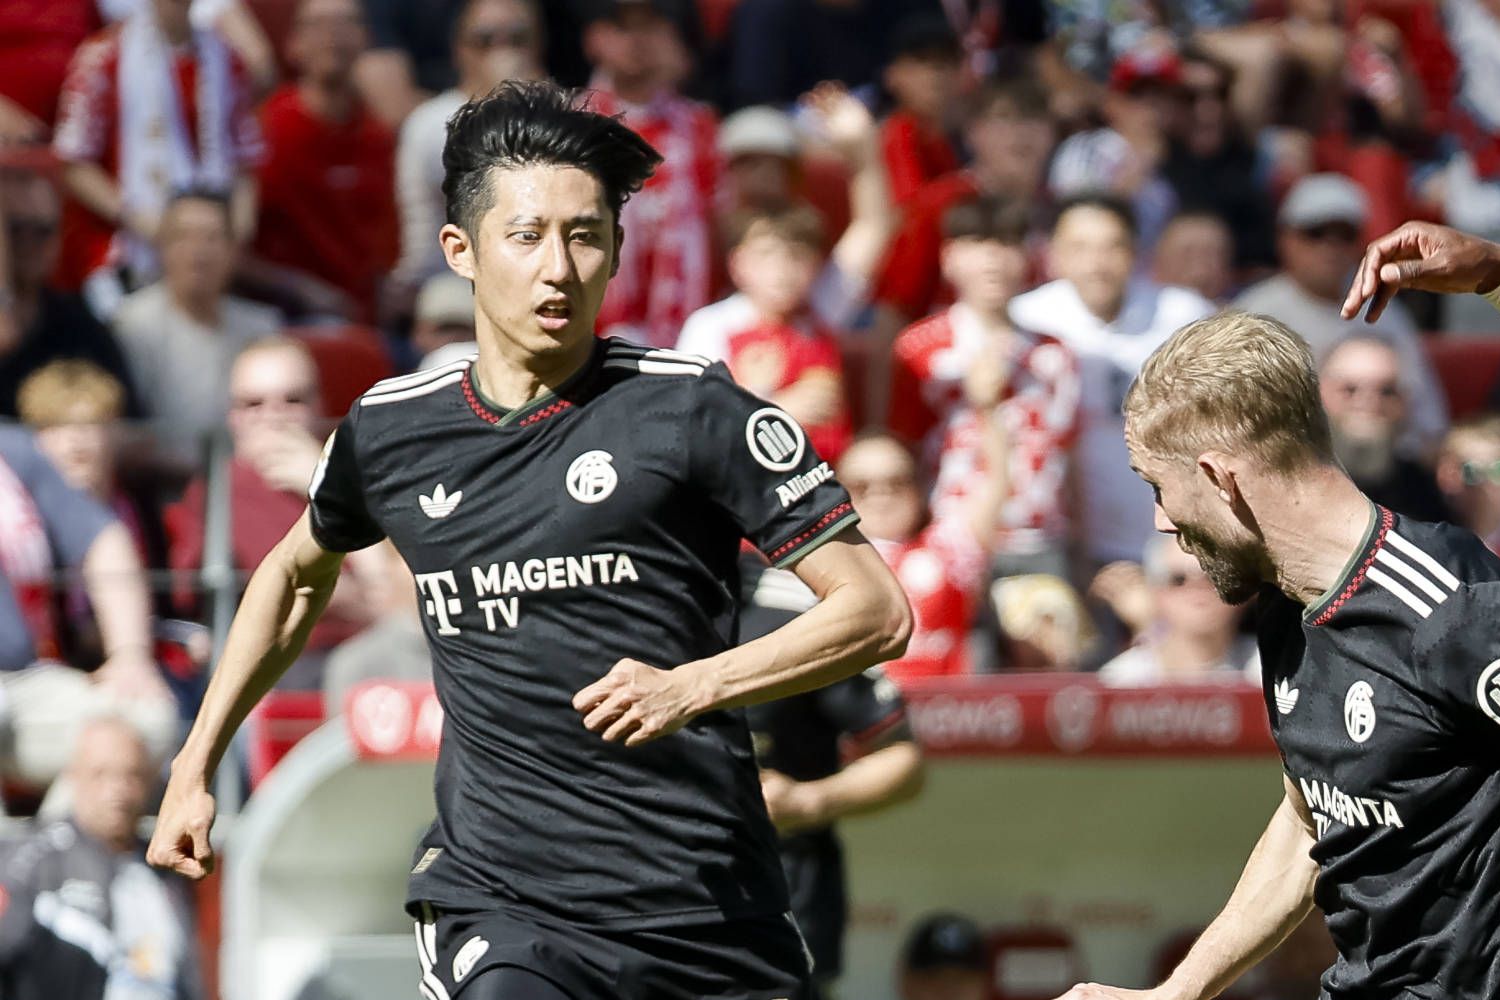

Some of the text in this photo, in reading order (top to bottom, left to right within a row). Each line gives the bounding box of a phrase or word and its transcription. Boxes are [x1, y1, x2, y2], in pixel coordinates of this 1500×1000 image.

[775, 461, 834, 508] Allianz
[471, 553, 639, 597] MAGENTA
[477, 597, 519, 632] TV
[1299, 777, 1404, 829] MAGENTA
